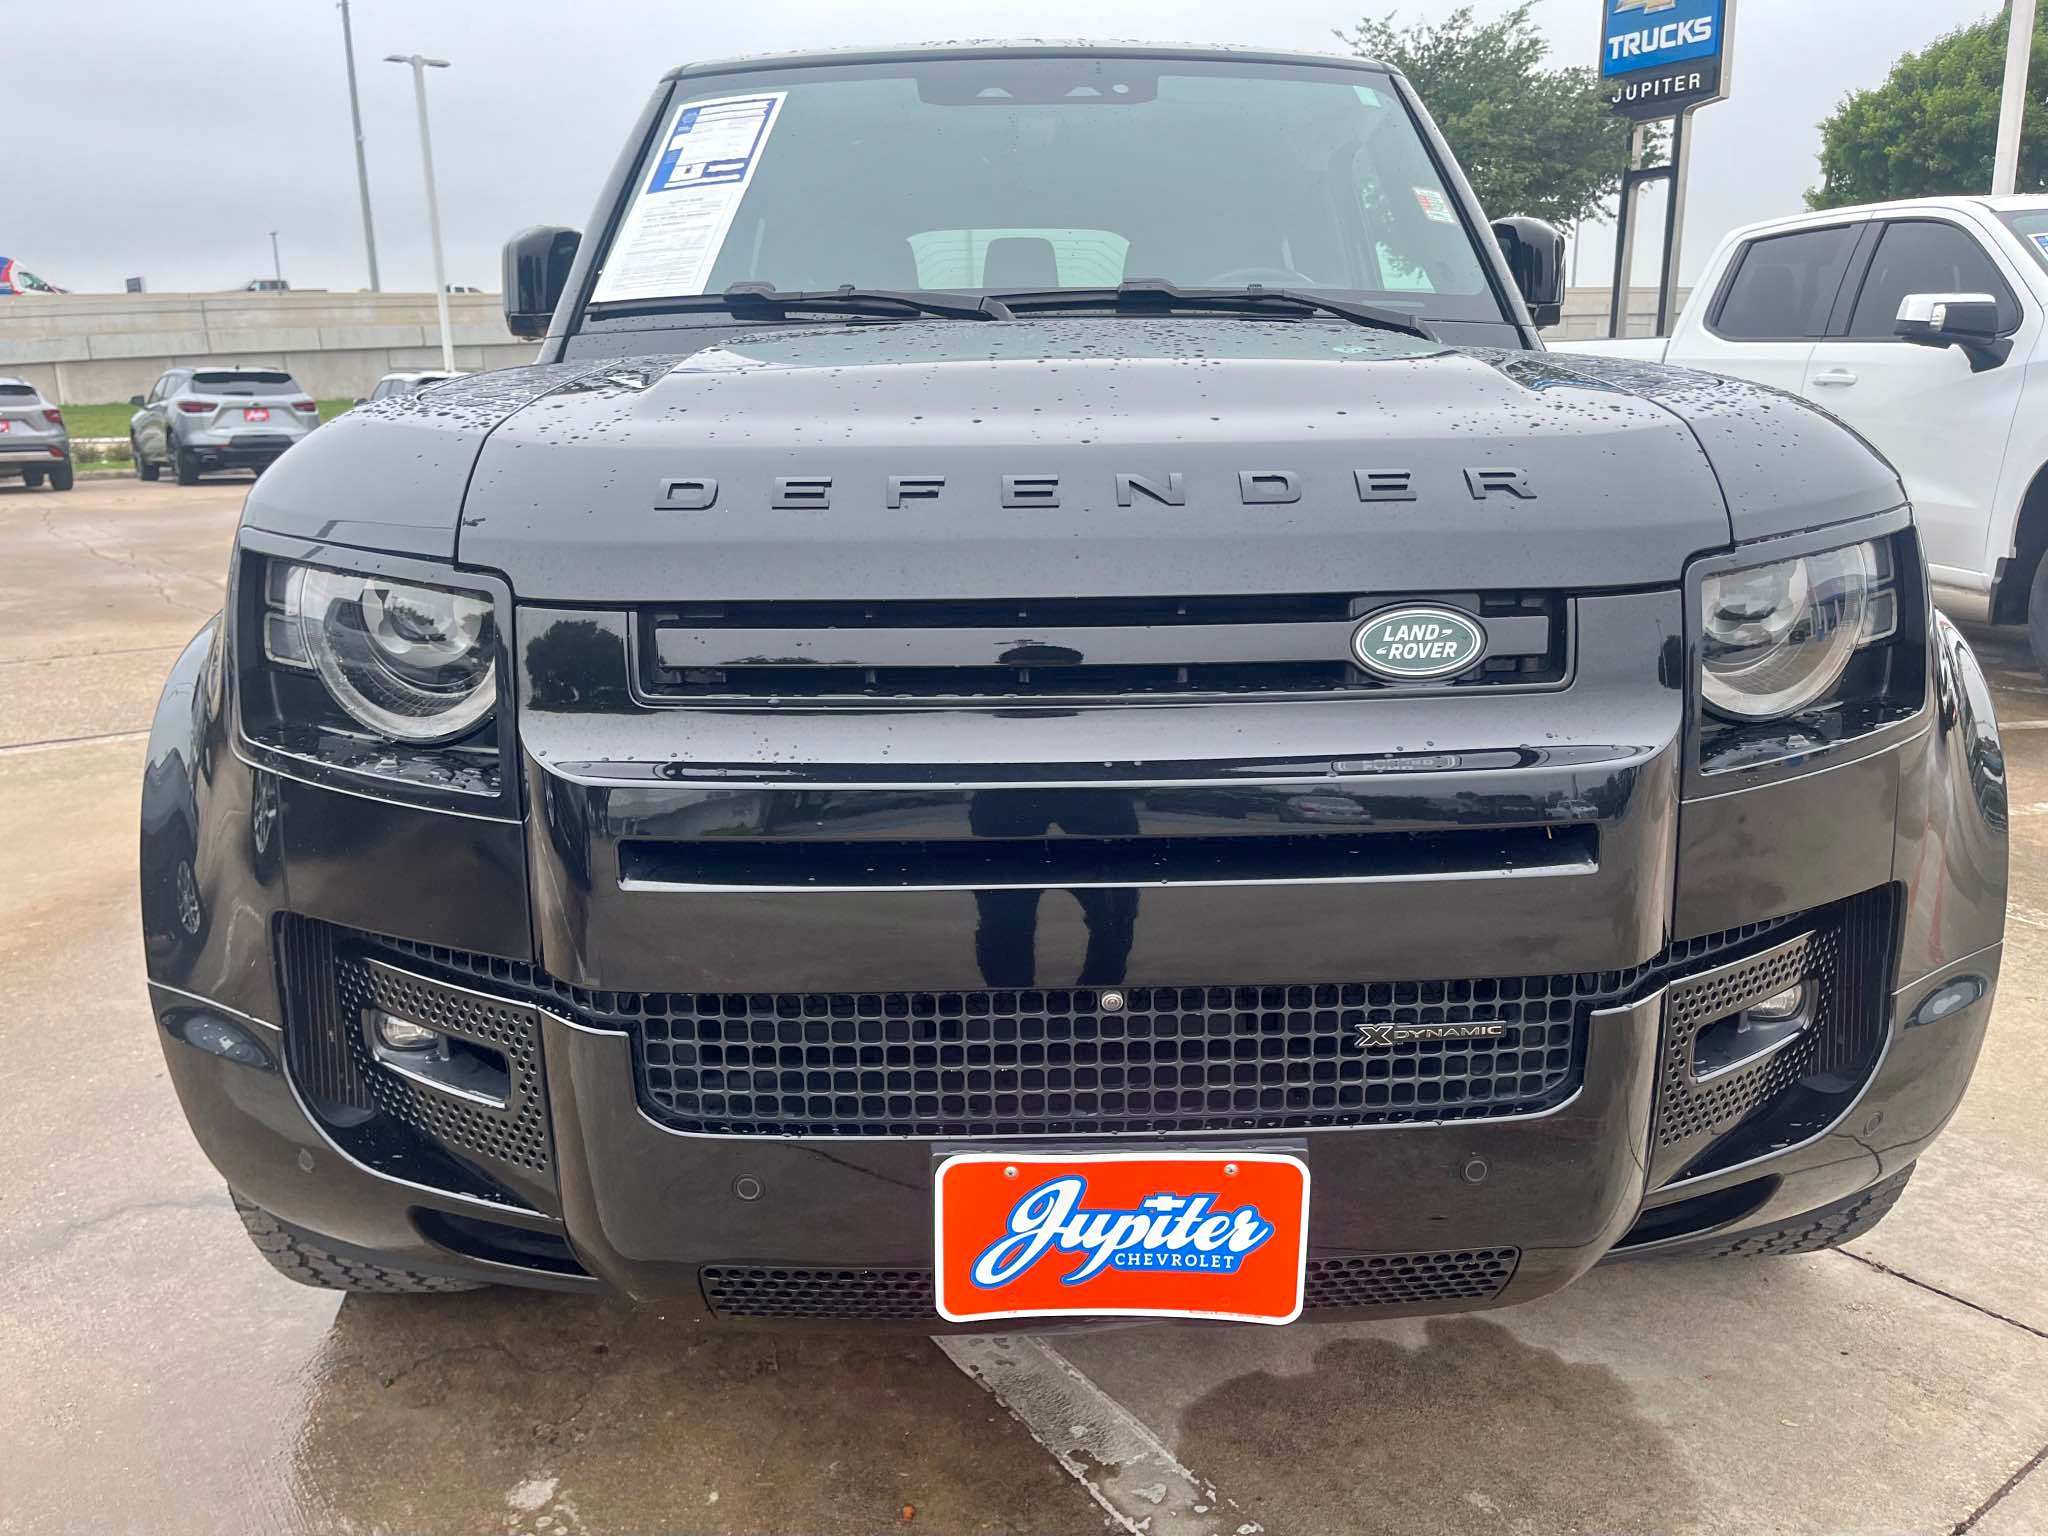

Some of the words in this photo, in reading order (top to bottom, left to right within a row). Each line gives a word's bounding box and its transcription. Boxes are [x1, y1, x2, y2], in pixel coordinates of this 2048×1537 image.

[1608, 16, 1712, 59] TRUCKS
[1612, 73, 1701, 103] JUPITER
[654, 467, 1537, 510] DEFENDER
[1382, 624, 1440, 642] LAND
[1388, 641, 1458, 660] ROVER
[973, 1178, 1271, 1285] Jupiter
[1115, 1252, 1235, 1270] CHEVROLET
